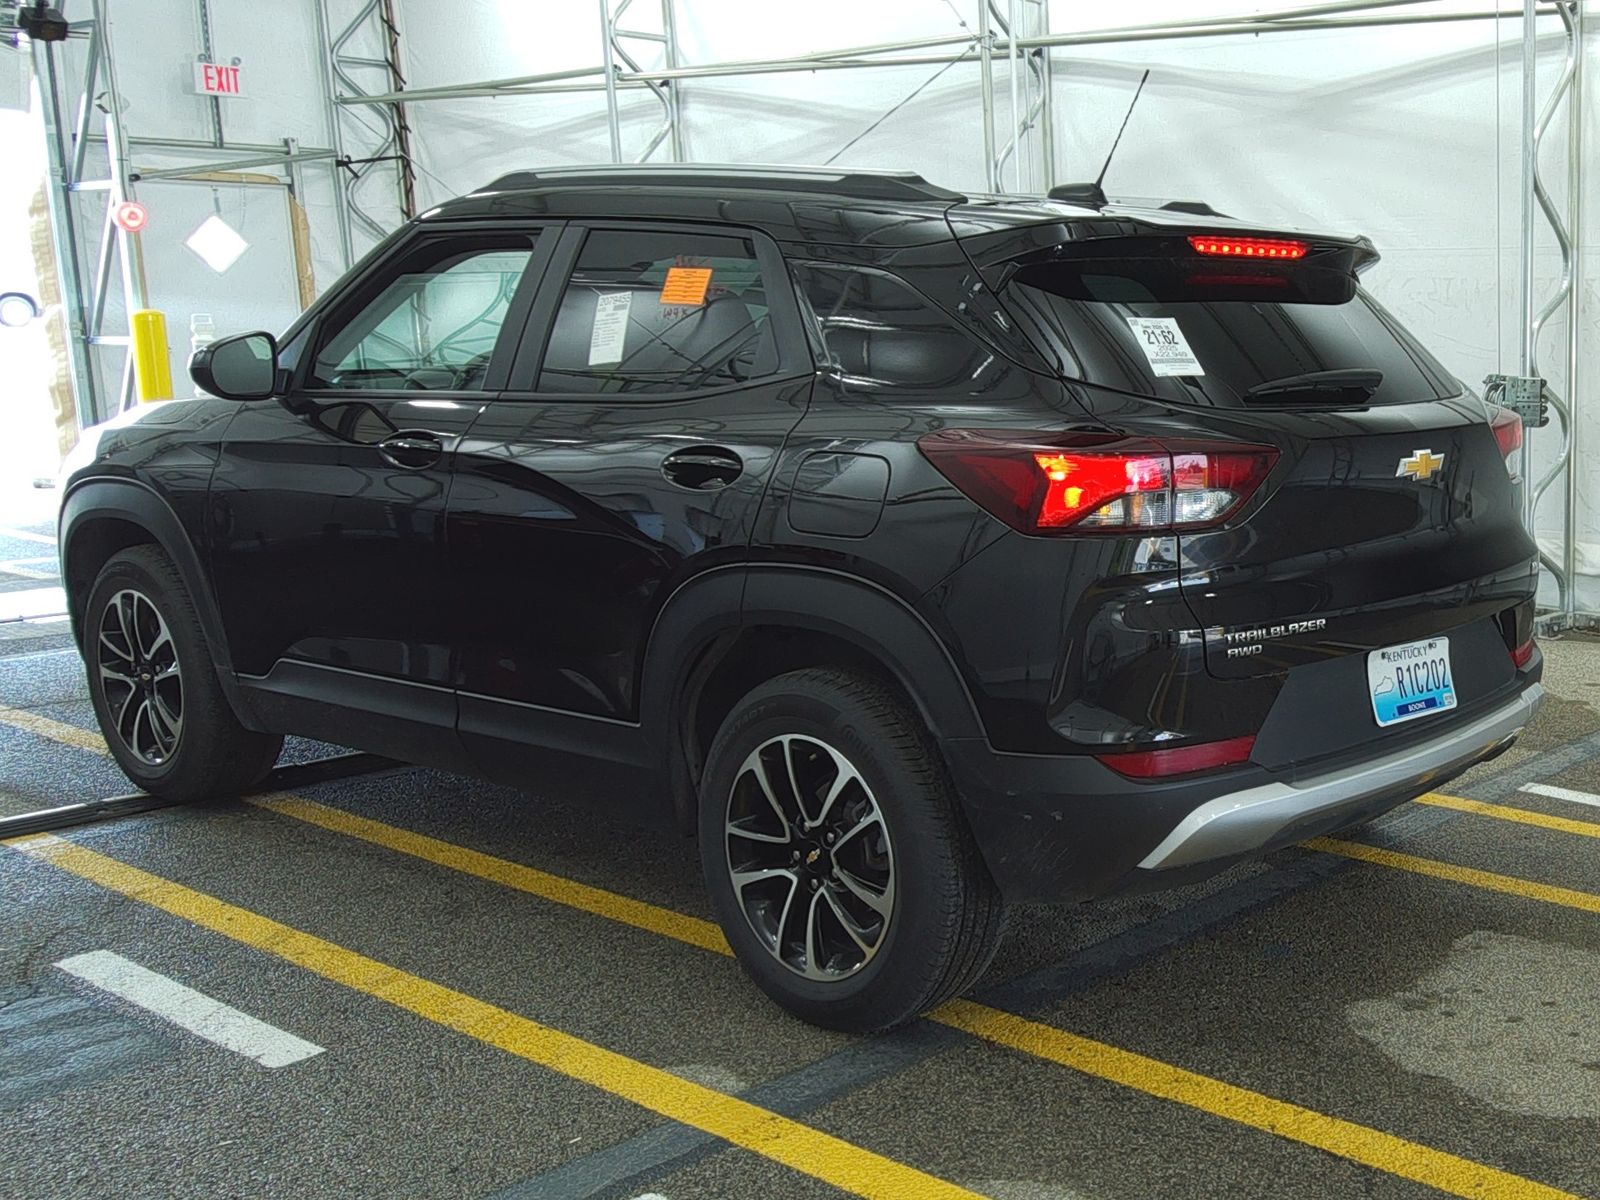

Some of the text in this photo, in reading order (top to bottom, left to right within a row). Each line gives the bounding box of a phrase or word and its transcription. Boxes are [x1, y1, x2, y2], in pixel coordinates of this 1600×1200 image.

[203, 65, 239, 93] EXIT
[1143, 329, 1179, 345] 21:62
[1224, 618, 1327, 644] TRAILBLAZER
[1227, 644, 1263, 659] AWD
[1387, 645, 1429, 663] KENTUCKY
[1396, 657, 1450, 699] R1C202
